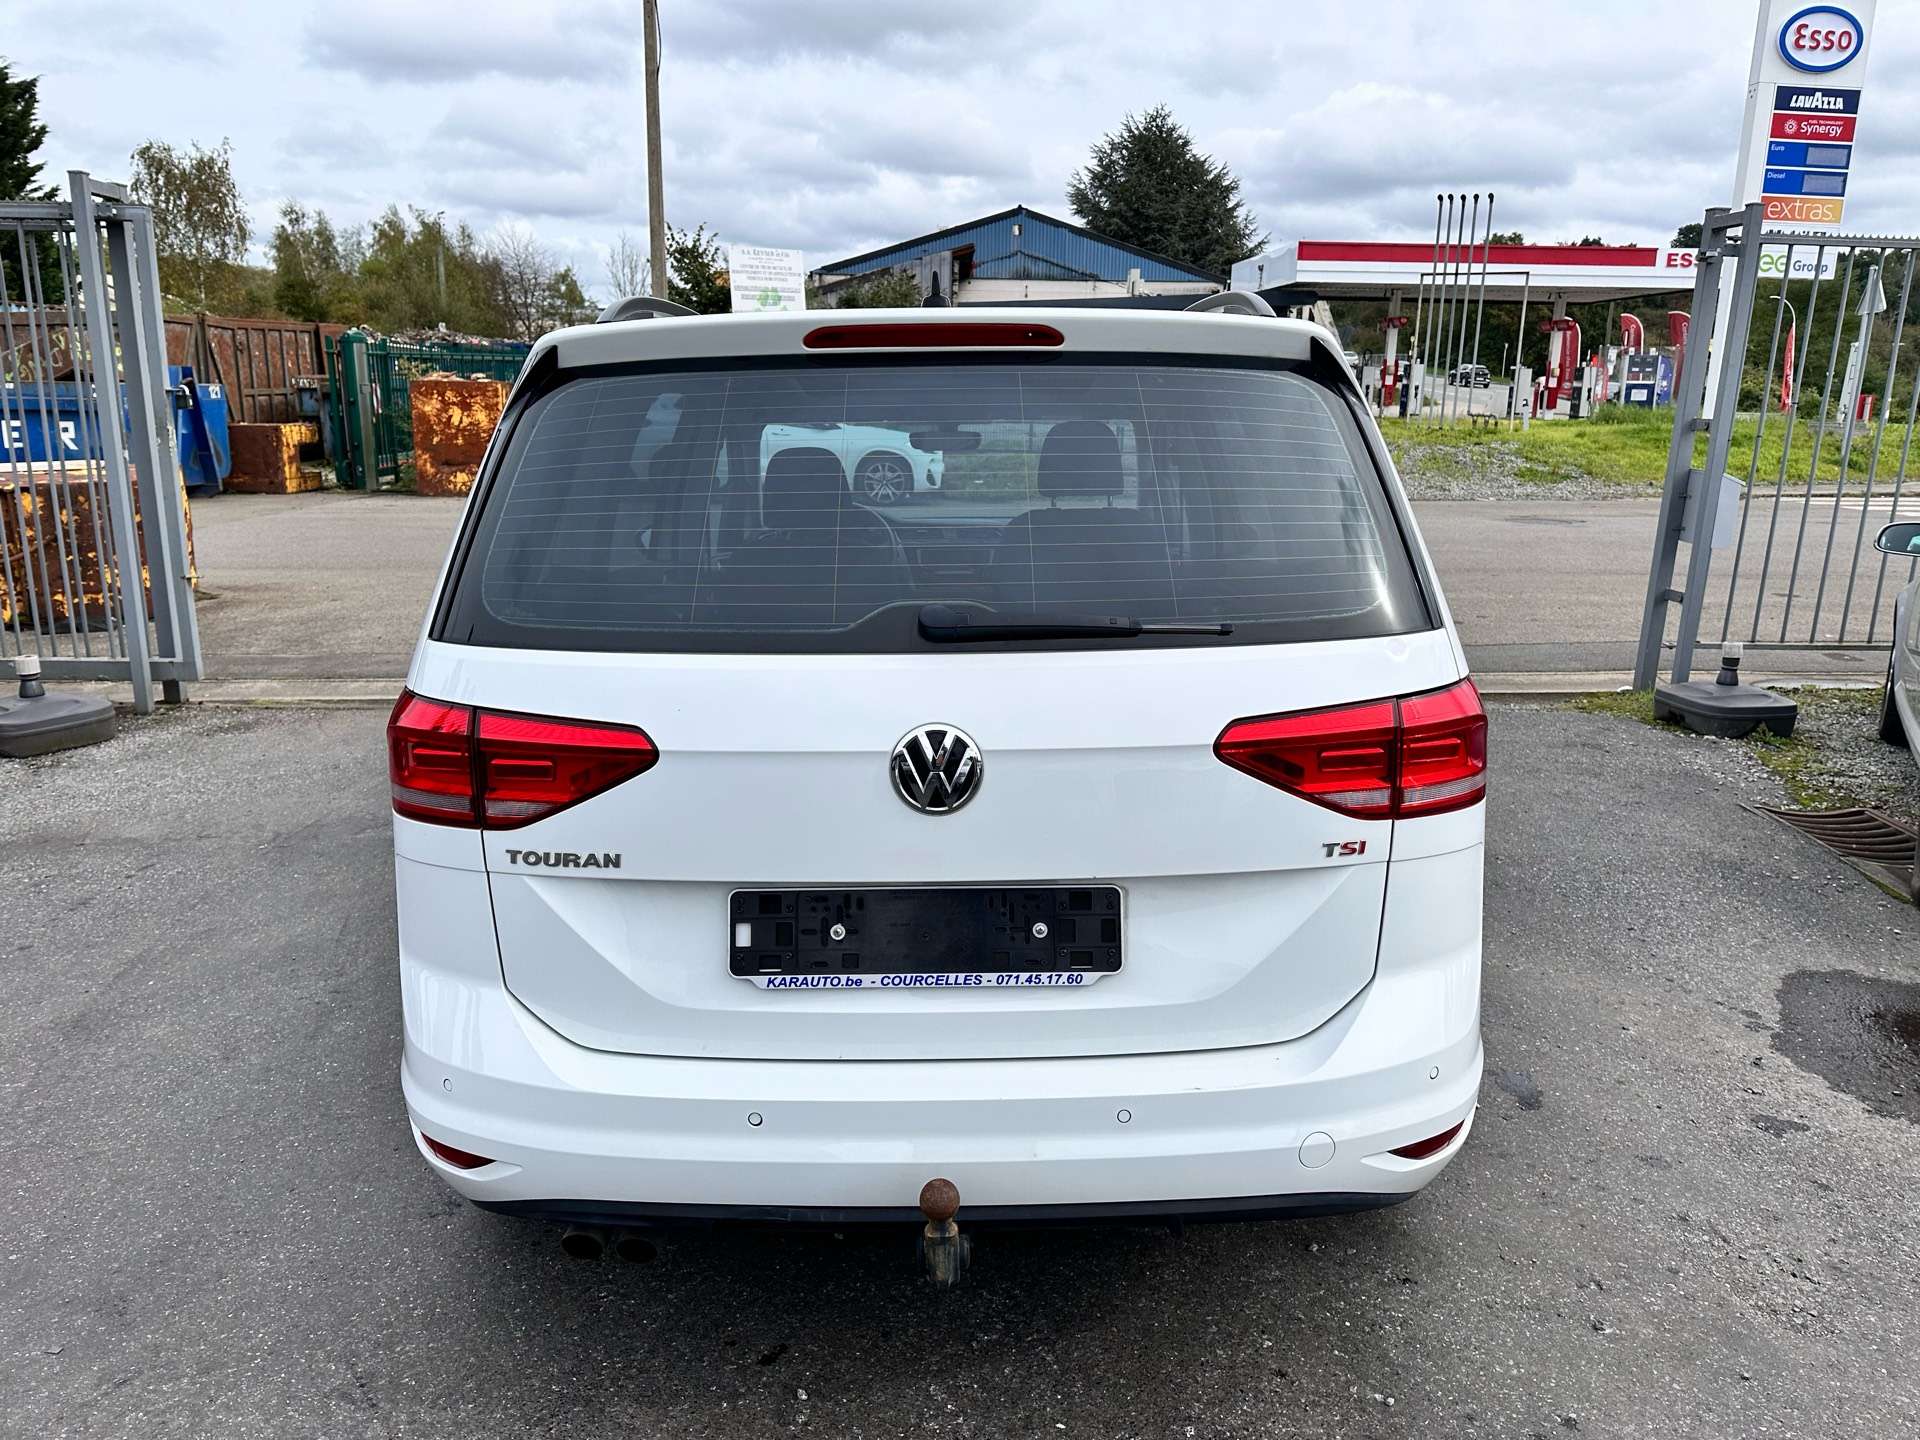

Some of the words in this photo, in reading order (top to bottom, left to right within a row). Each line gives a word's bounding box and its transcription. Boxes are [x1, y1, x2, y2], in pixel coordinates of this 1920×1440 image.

[1789, 91, 1844, 110] LAVAZZA
[1800, 121, 1844, 137] Synergy
[1771, 143, 1785, 151] Euro
[1767, 171, 1786, 179] Diesel
[1767, 199, 1834, 221] extras
[1666, 253, 1697, 268] ES
[1322, 840, 1366, 857] TSI
[505, 849, 621, 868] TOURAN
[766, 977, 862, 988] KARAUTO.be
[880, 975, 983, 987] COURCELLES
[995, 973, 1083, 985] 071.45.17.60
